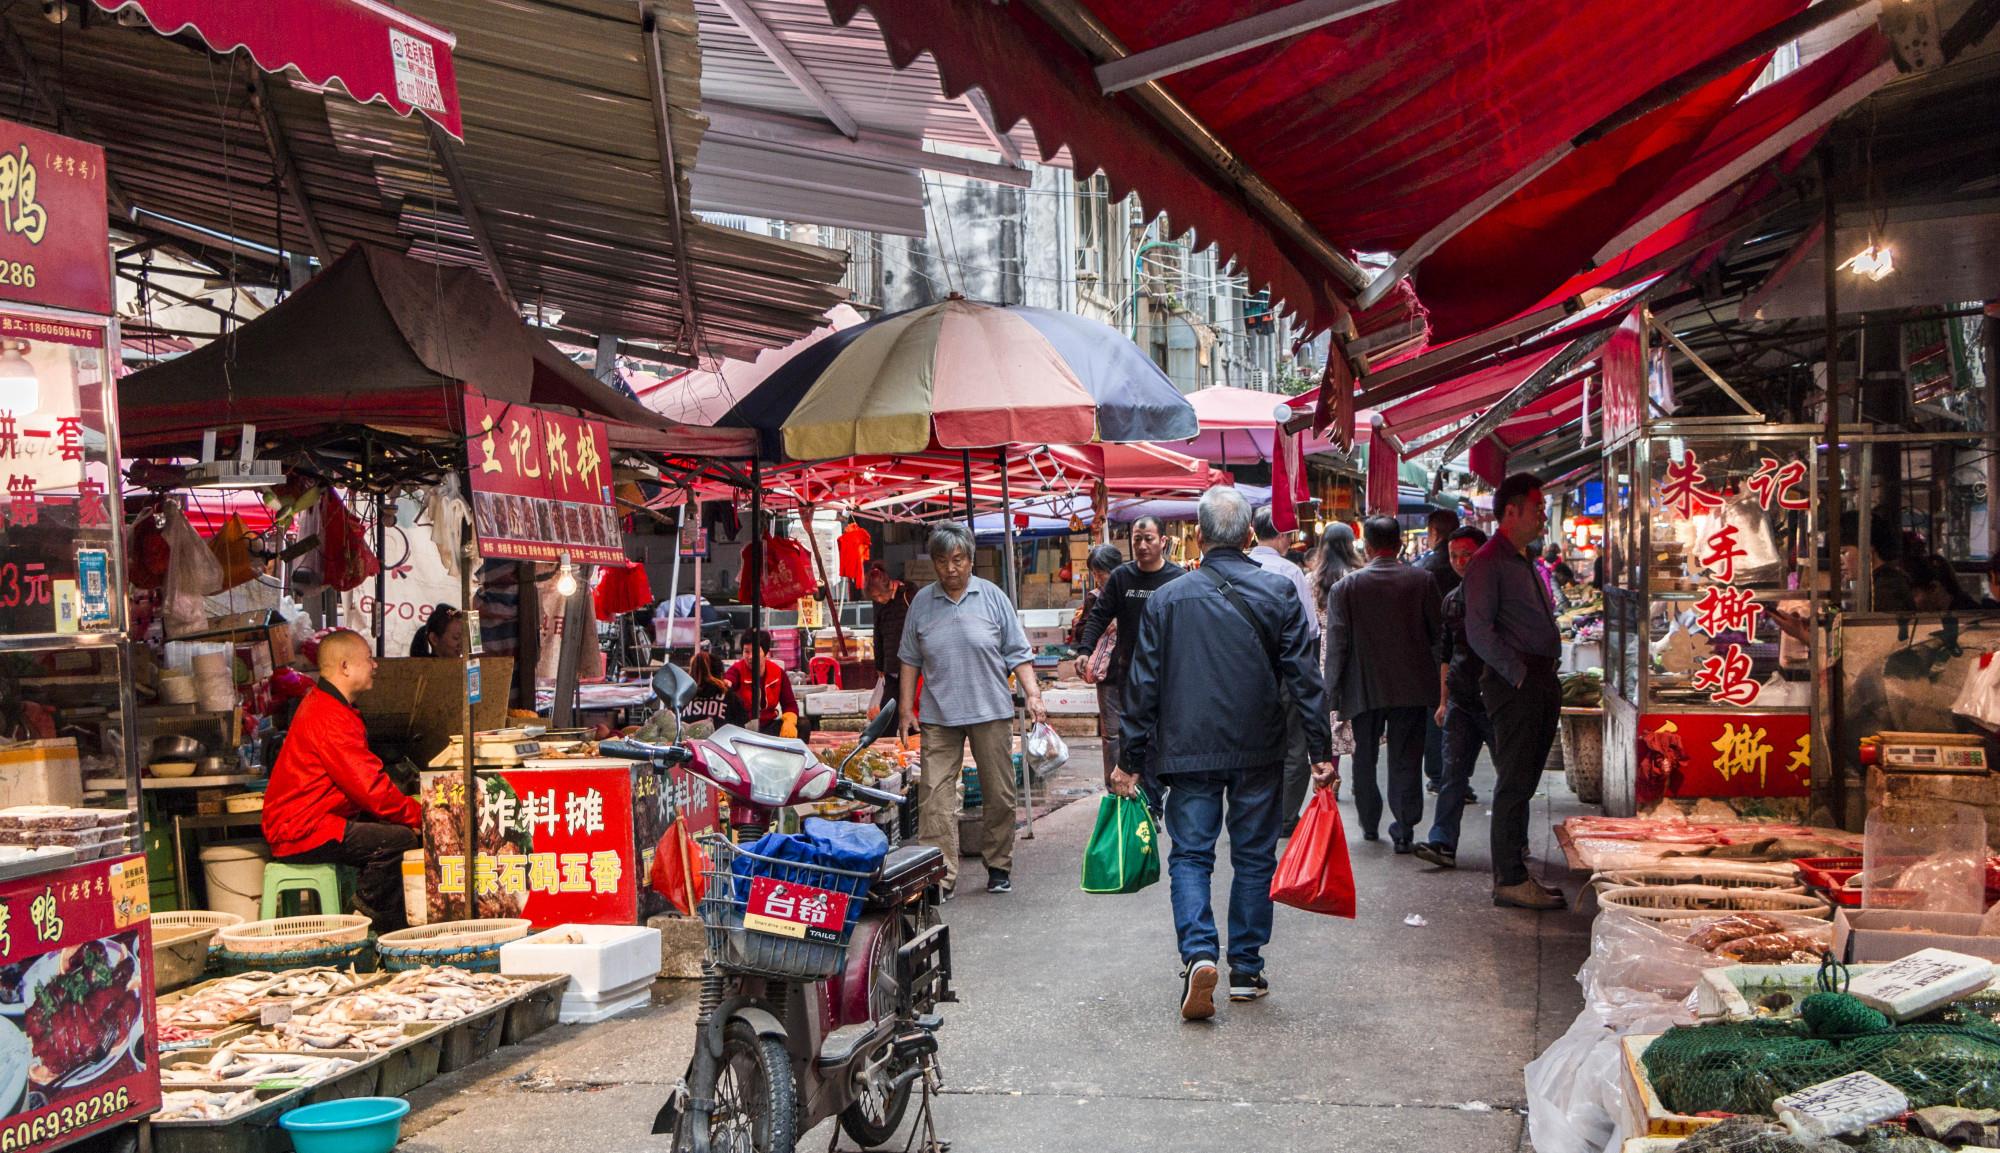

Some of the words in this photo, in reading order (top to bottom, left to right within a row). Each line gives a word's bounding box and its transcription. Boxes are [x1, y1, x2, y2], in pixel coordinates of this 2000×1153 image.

[46, 152, 96, 180] (老字号)
[0, 260, 36, 288] 286
[481, 414, 602, 501] 王记炸料
[0, 474, 107, 528] 第一家
[1660, 449, 1810, 518] 朱记
[0, 562, 51, 608] 3元
[1693, 523, 1762, 707] 手撕鸡
[479, 787, 605, 837] 炸料摊
[438, 849, 622, 895] 正宗石码五香
[764, 889, 828, 923] 台铃
[809, 929, 836, 941] TAILG
[2, 1086, 129, 1153] 606938286
